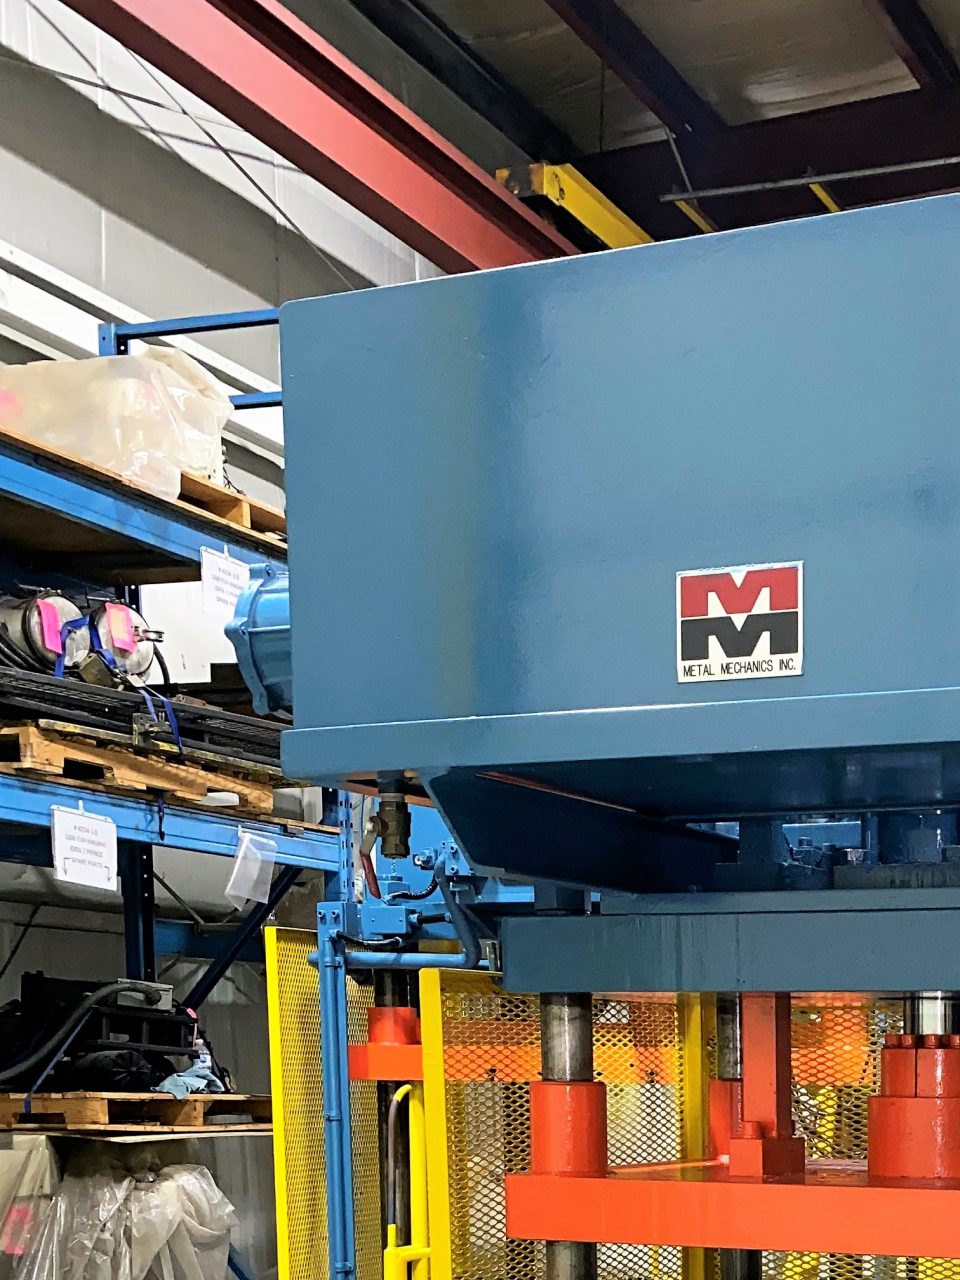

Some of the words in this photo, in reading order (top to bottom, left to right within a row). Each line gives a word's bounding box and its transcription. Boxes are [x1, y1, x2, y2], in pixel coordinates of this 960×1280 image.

[683, 664, 715, 677] METAL
[720, 660, 773, 674] MECHANICS
[779, 658, 796, 671] INC.
